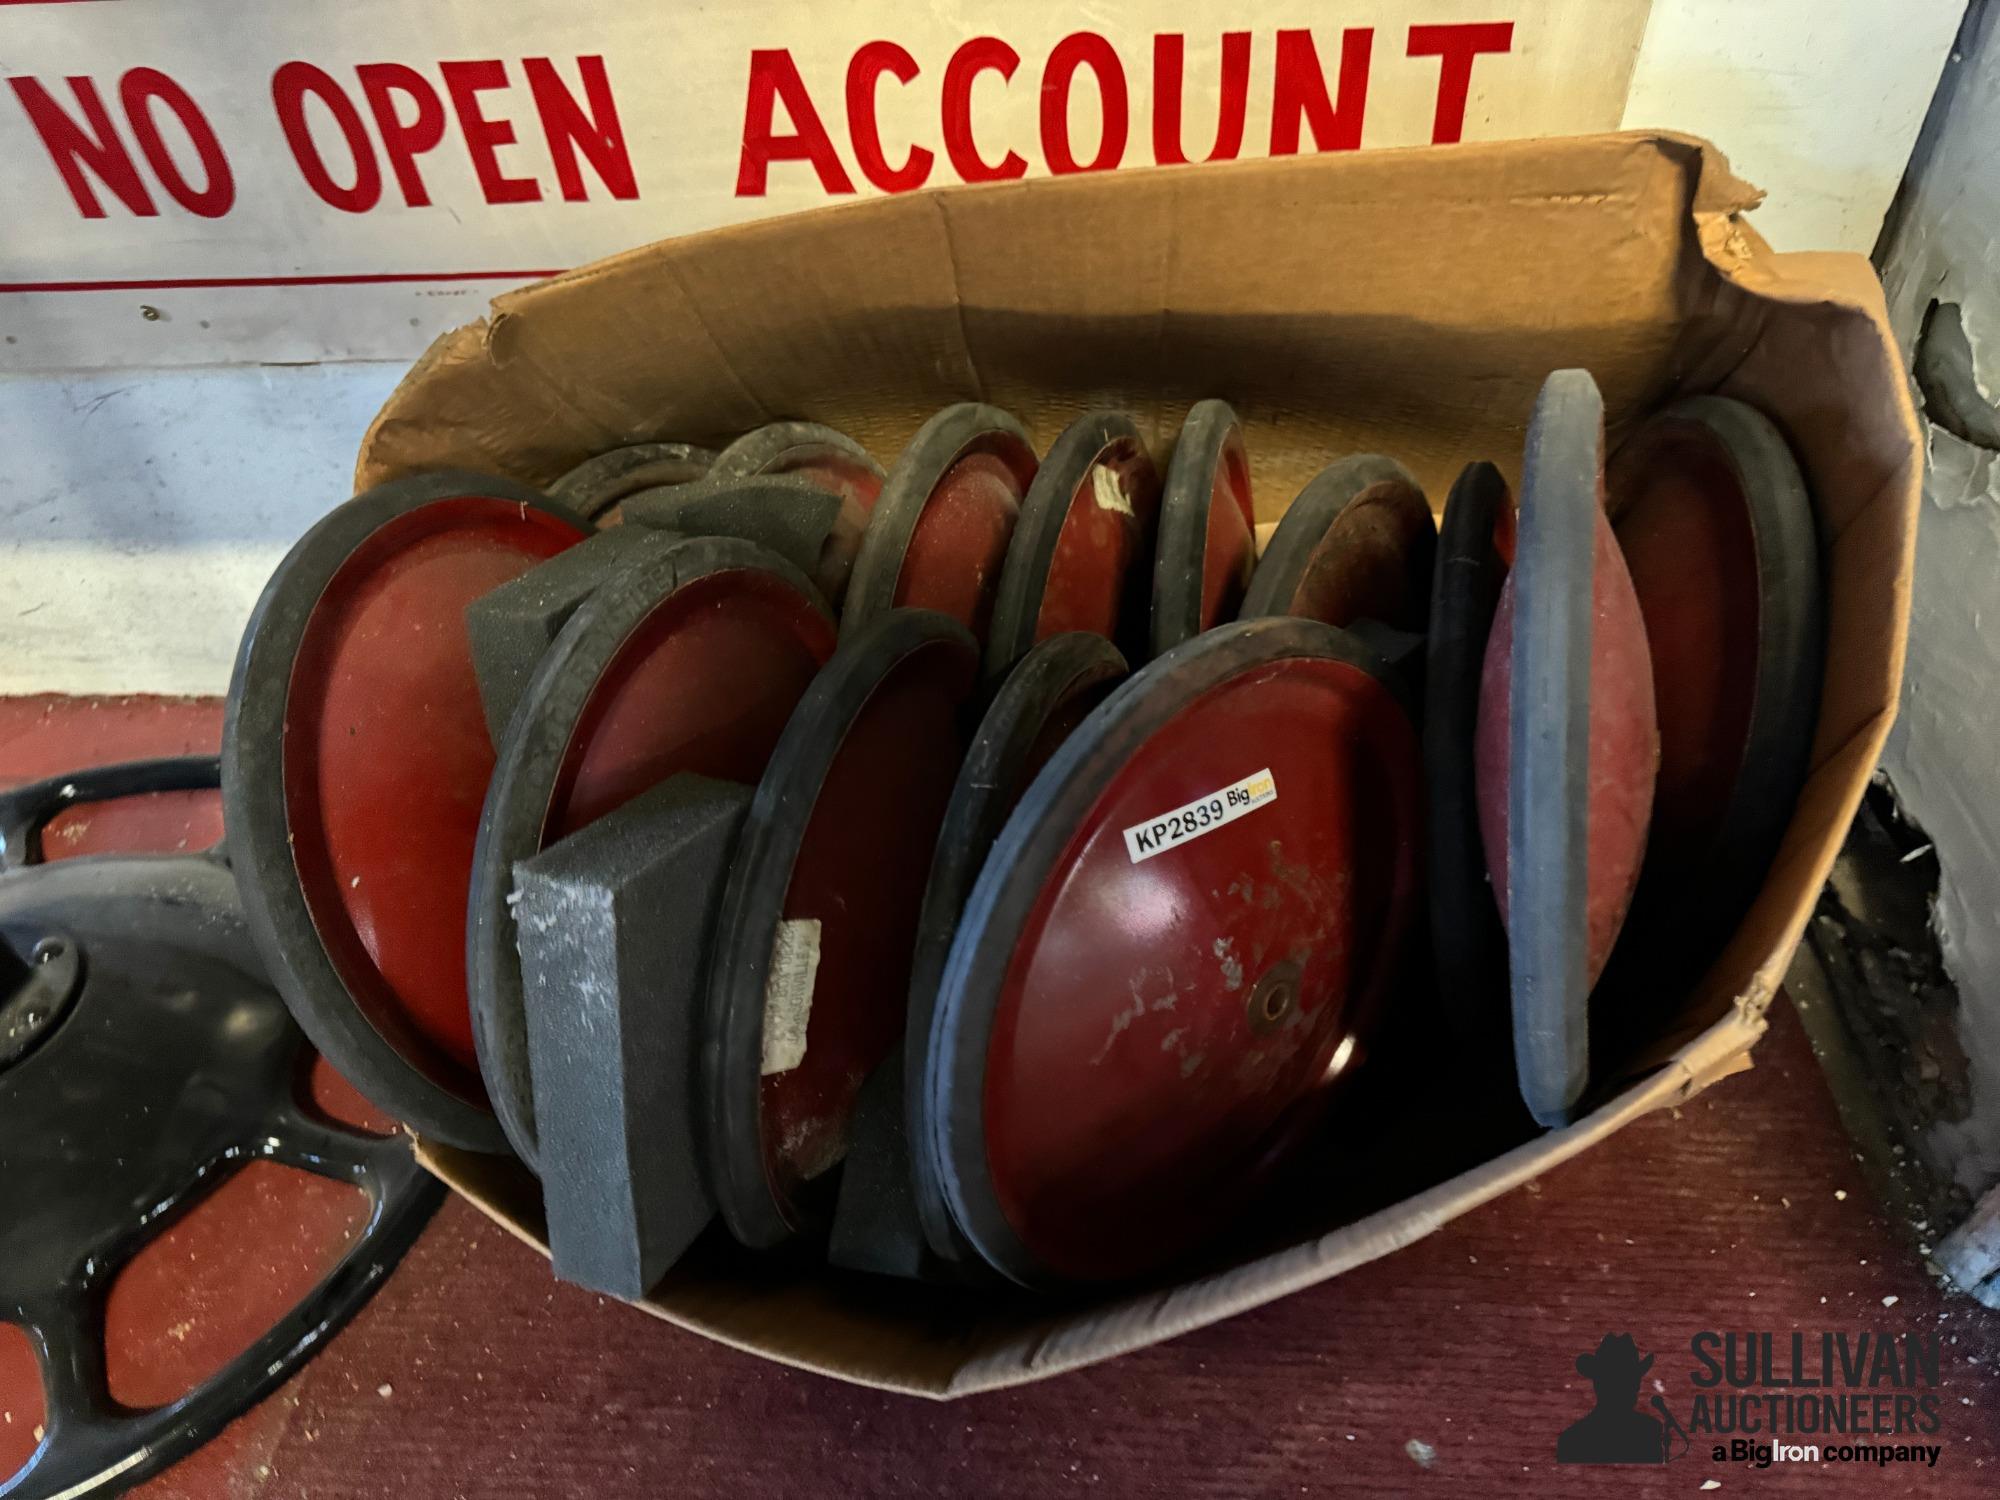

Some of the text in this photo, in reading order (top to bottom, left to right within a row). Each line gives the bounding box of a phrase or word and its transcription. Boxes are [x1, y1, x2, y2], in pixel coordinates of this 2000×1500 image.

[7, 22, 1514, 219] NO OPEN ACCOUNT
[1135, 799, 1224, 853] KP2839
